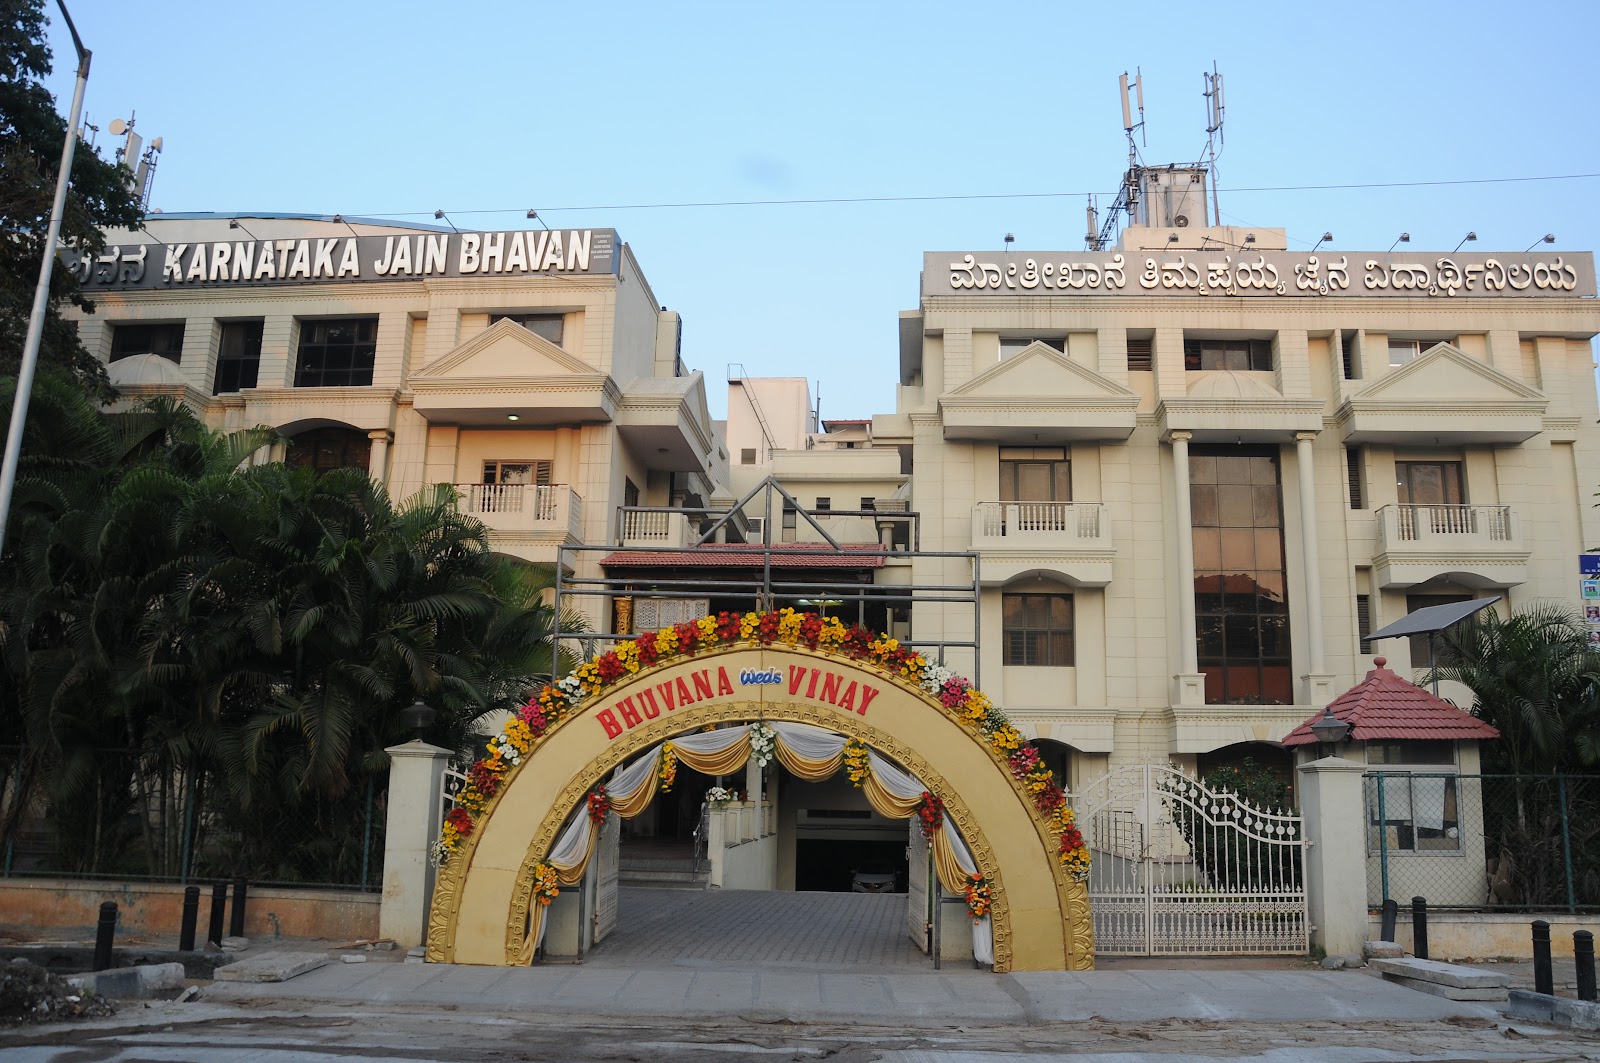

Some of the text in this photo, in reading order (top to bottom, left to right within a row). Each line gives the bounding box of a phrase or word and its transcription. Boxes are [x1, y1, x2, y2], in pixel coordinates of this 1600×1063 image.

[163, 230, 591, 282] KARNATAKA JAIN BHAVAN
[1139, 255, 1286, 295] ತಿಮ್ಮಪ್ಪಯ್ಯ
[1295, 255, 1350, 295] ಜೈನ
[1364, 256, 1577, 297] ವಿದ್ಯಾರ್ಥಿನಿಲಯ
[596, 666, 734, 740] BHUVANA
[788, 664, 879, 716] VINAY
